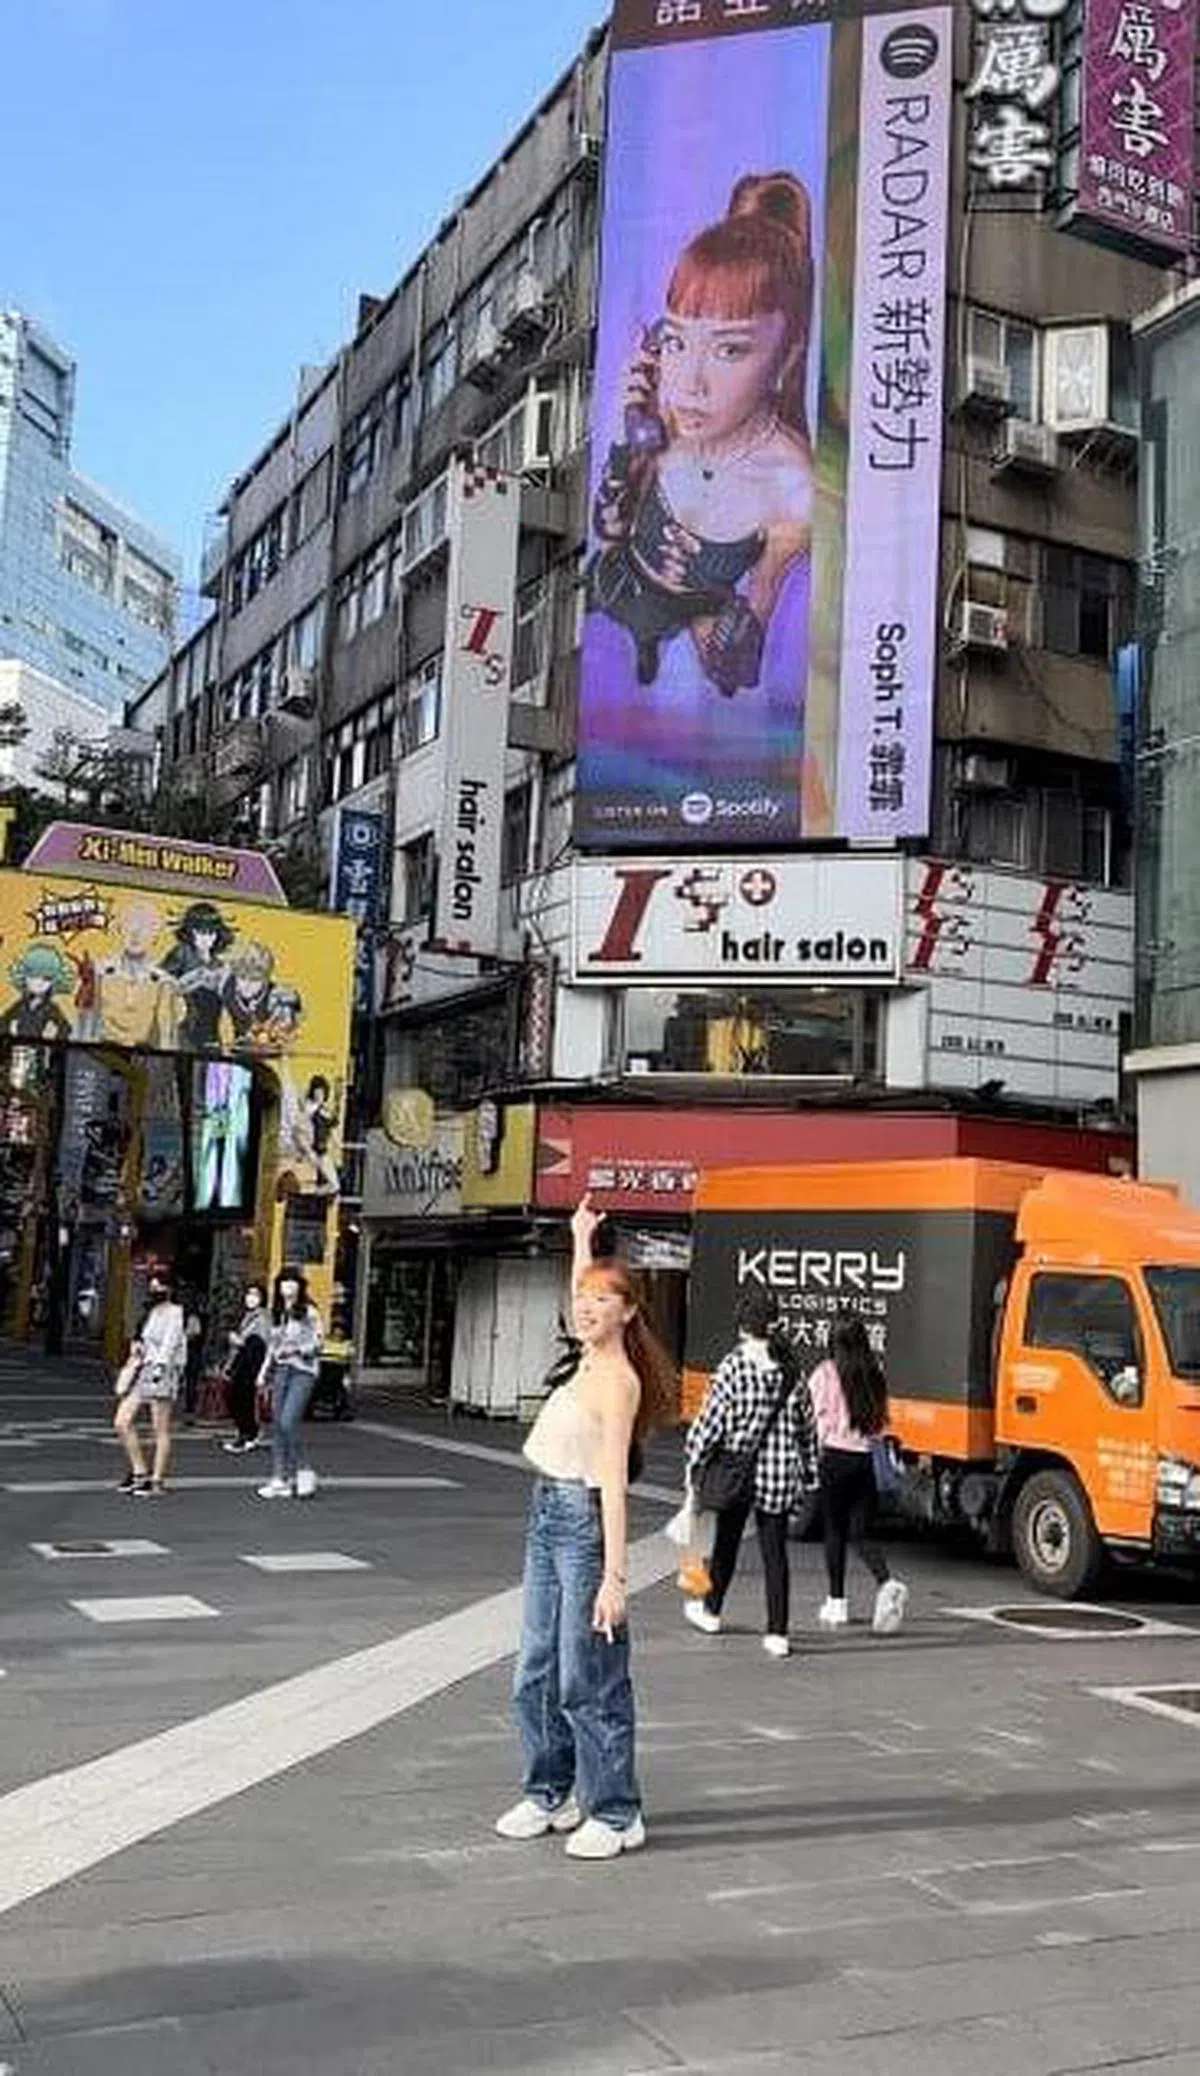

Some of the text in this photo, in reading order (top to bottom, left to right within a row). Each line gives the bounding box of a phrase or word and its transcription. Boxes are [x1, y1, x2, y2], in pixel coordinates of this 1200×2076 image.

[965, 0, 1058, 186] 厲害
[868, 94, 933, 470] RADAR 新勢力
[869, 623, 906, 702] Soph
[873, 706, 903, 736] T.
[161, 847, 235, 881] Walker
[452, 779, 489, 921] hair salon
[721, 931, 889, 962] hair salon
[737, 1249, 905, 1291] KERRY
[777, 1293, 888, 1316] LOGISTICS
